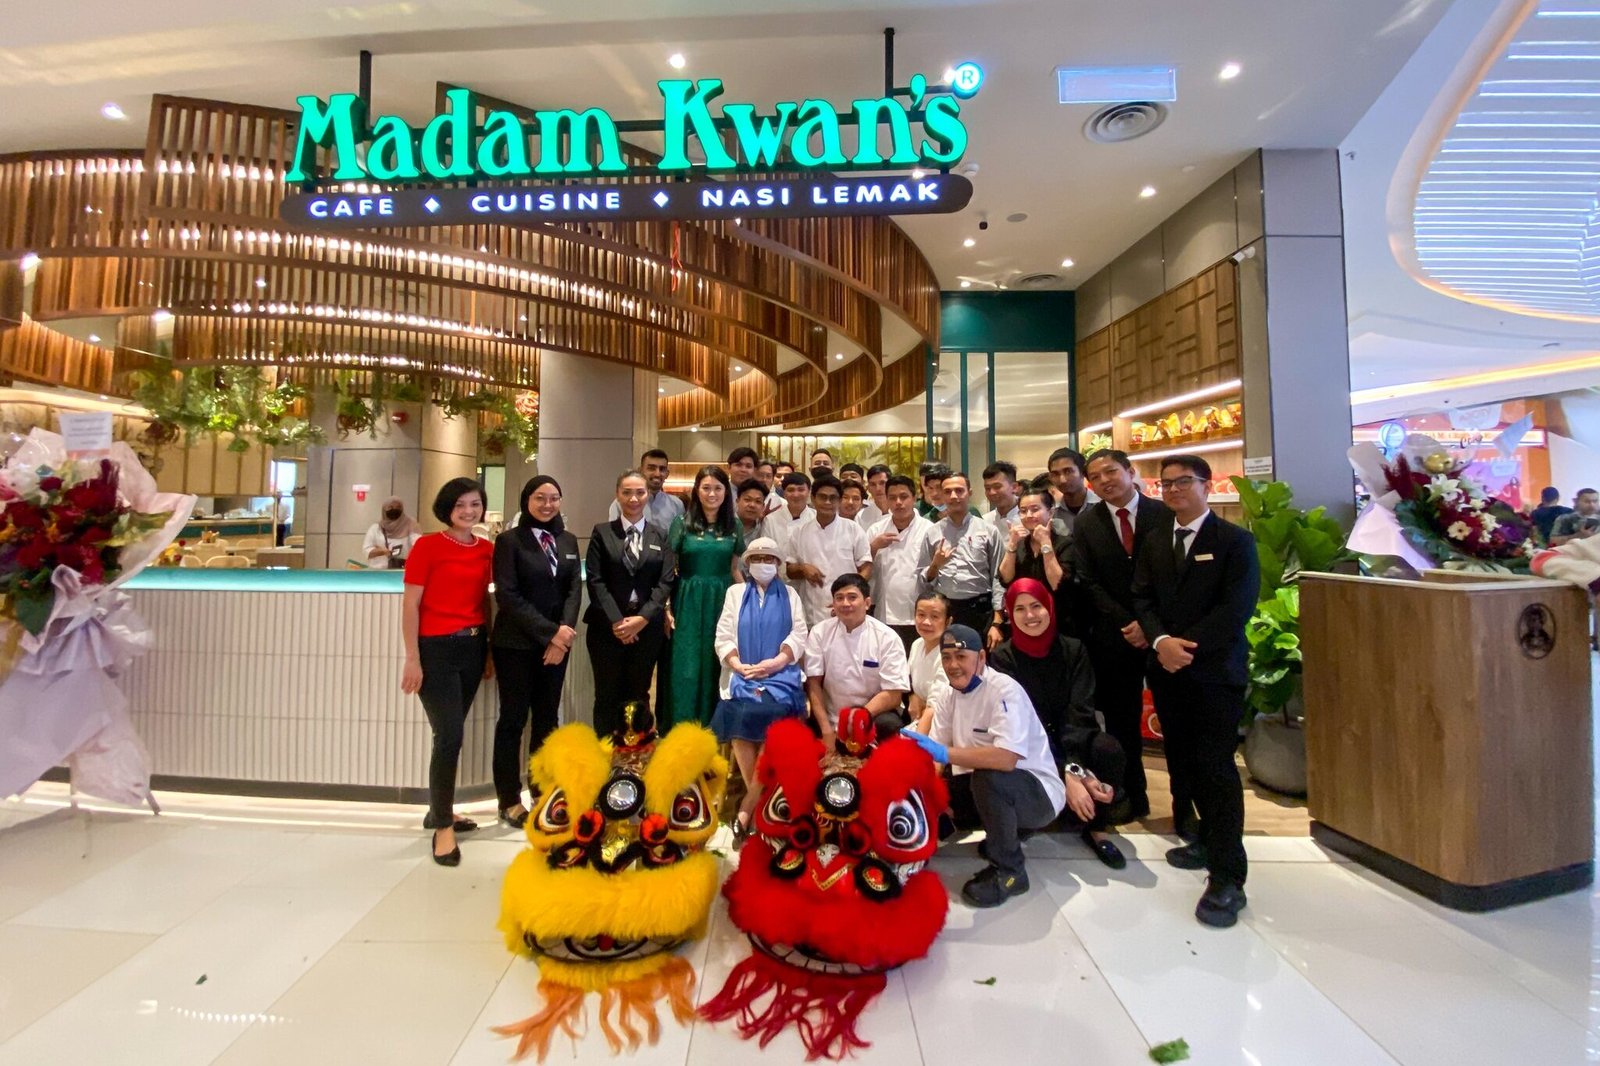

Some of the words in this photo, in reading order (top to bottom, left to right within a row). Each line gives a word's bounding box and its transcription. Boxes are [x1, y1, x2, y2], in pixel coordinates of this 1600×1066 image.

[284, 88, 630, 182] Madam
[657, 73, 969, 170] Kwan's
[309, 198, 395, 218] CAFE
[471, 191, 621, 213] CUISINE
[702, 187, 789, 208] NASI
[812, 182, 940, 205] LEMAK
